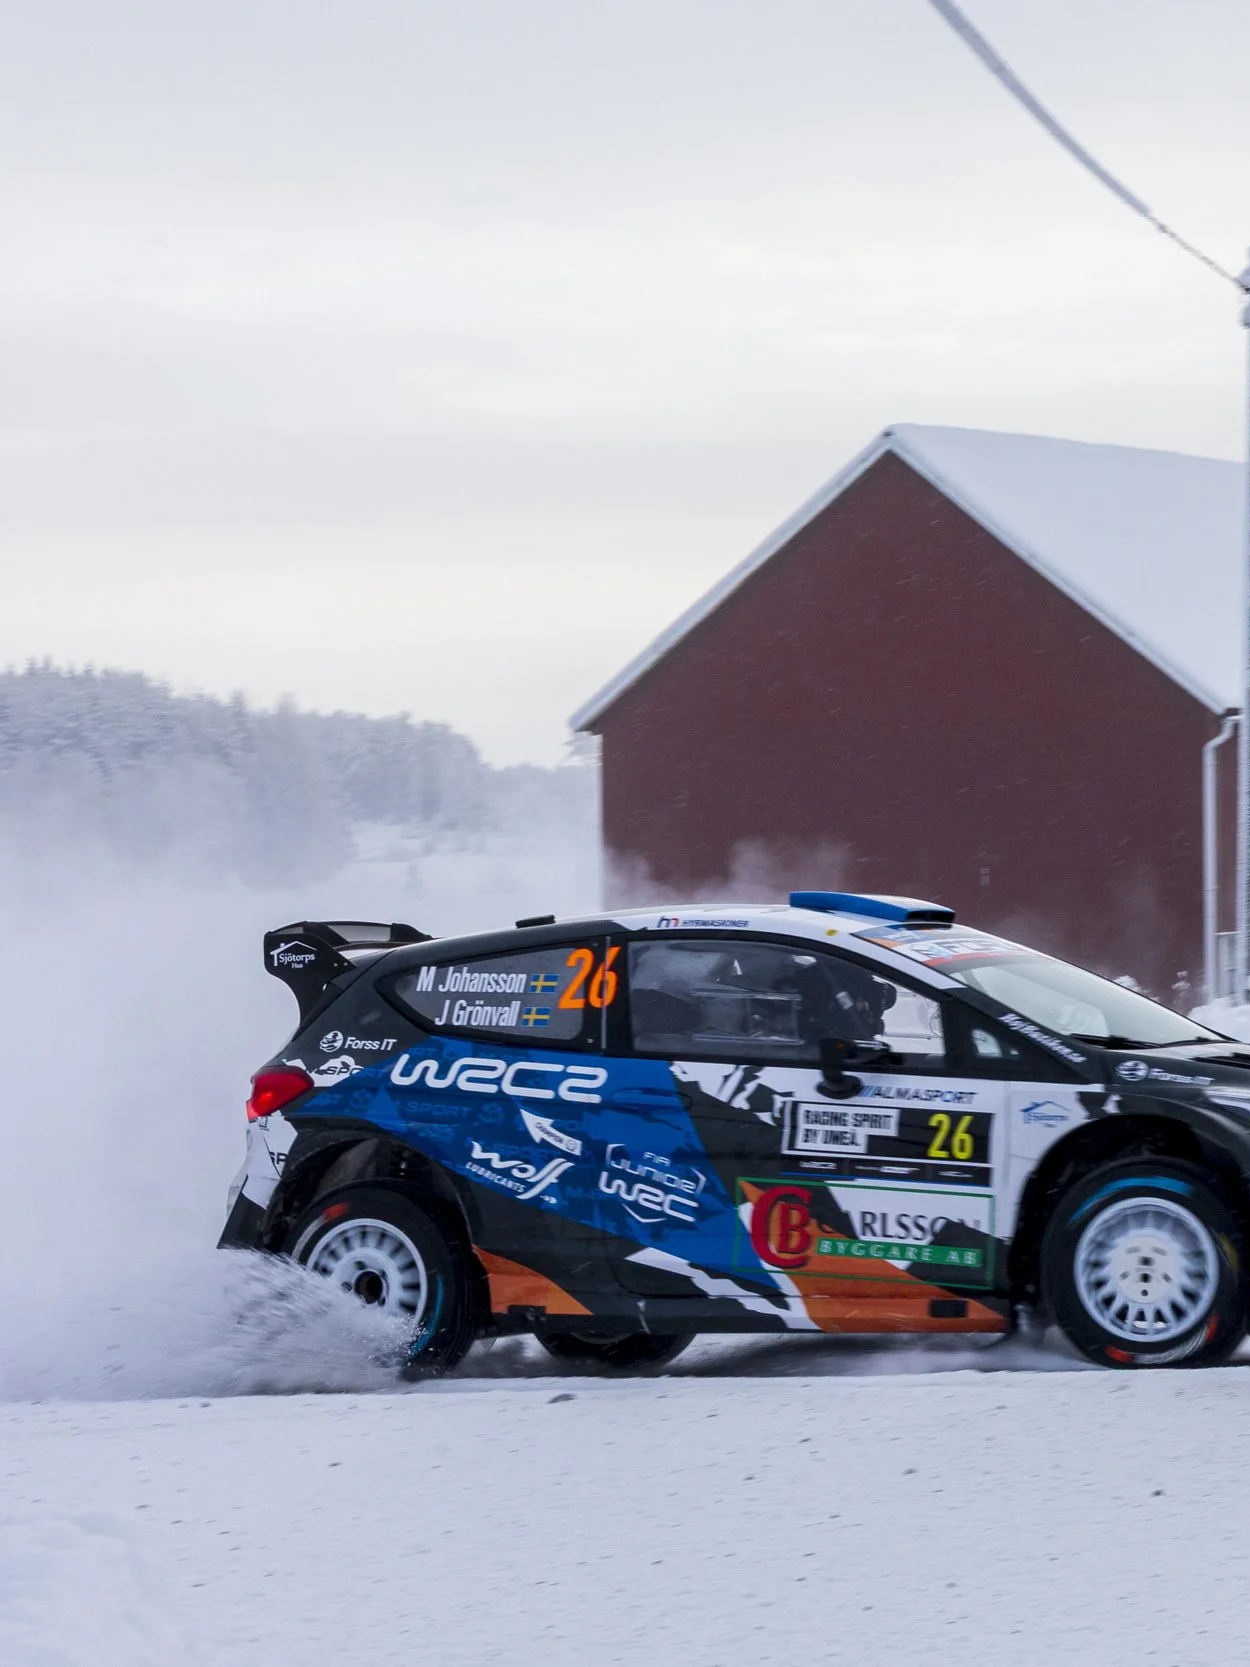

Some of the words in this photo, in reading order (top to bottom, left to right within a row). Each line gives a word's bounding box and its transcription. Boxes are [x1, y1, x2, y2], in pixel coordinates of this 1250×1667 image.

[278, 952, 316, 965] Sjötorps
[415, 966, 437, 992] M
[438, 966, 528, 993] Johansson
[557, 946, 622, 1010] 26
[434, 999, 451, 1026] J
[452, 999, 522, 1028] Grönvall
[344, 1036, 380, 1051] Forss
[380, 1038, 398, 1051] IT
[390, 1053, 609, 1105] WRC2
[803, 1109, 850, 1127] RACING
[852, 1112, 893, 1130] SPIRIT
[803, 1128, 819, 1145] BY
[926, 1112, 975, 1161] 26
[643, 1151, 672, 1168] FIA
[464, 1161, 527, 1193] LUBRICANTS
[598, 1171, 700, 1223] WRC
[819, 1240, 933, 1262] BYGGARE
[944, 1249, 977, 1266] AB
